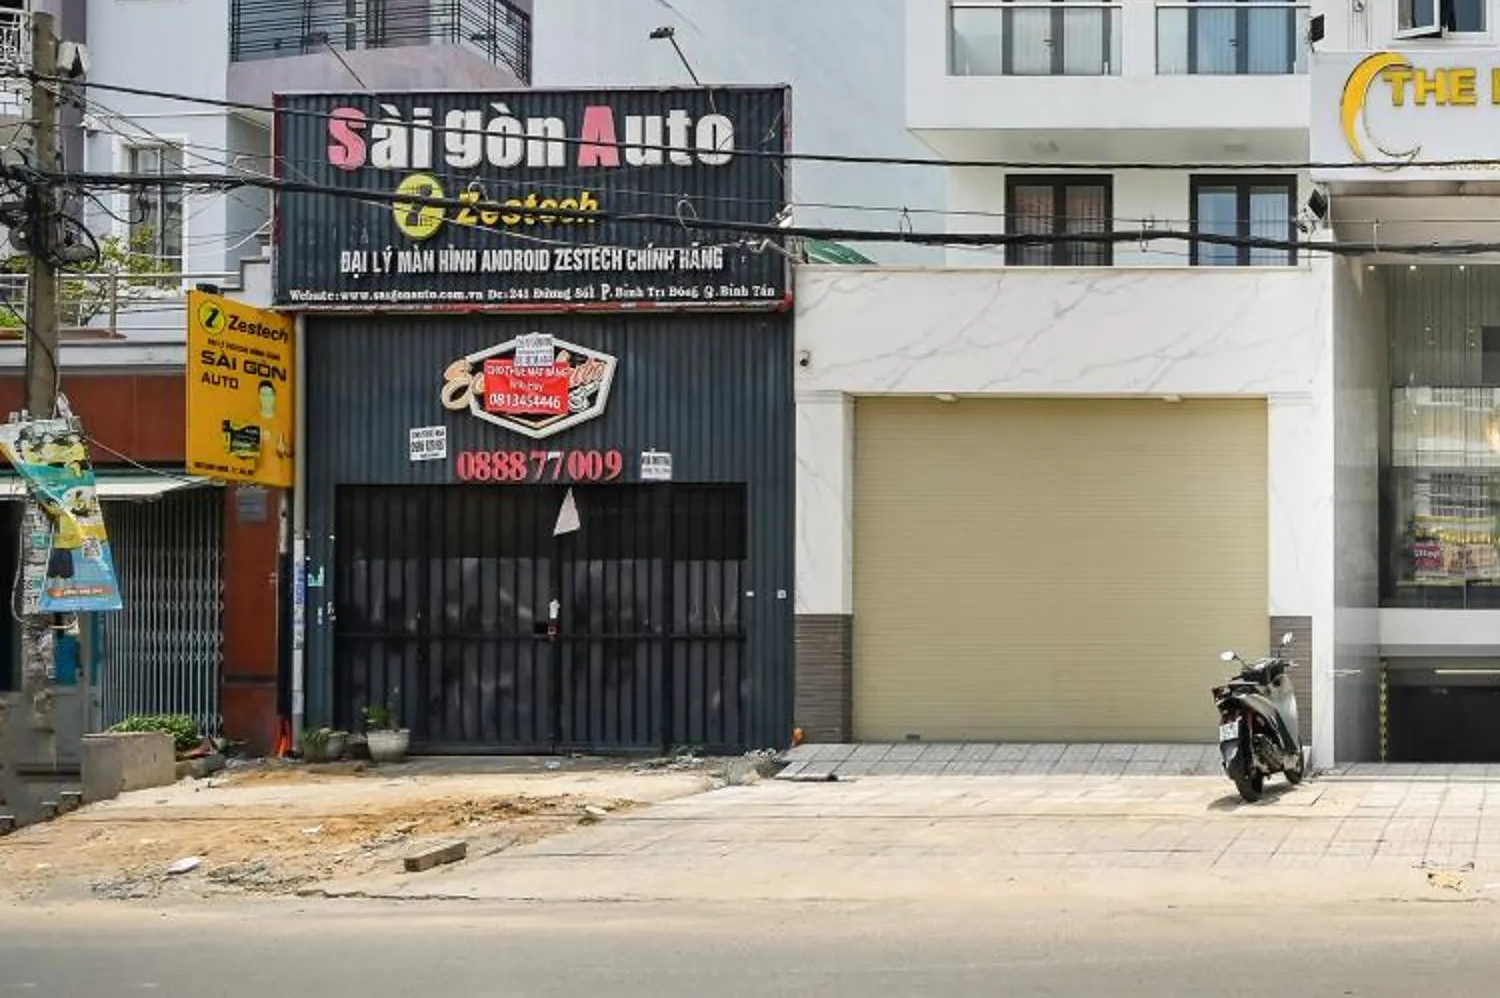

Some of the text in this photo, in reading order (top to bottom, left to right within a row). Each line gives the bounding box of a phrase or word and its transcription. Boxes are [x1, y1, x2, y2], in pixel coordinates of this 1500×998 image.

[1383, 67, 1477, 106] THE
[328, 102, 735, 170] Sài gòn Auto
[340, 241, 724, 279] ĐẠI LÝ MÀN HÌNH ANDROID ZESTECH CHÍNH HÃNG
[228, 314, 289, 344] Zestech
[201, 372, 239, 390] AUTO
